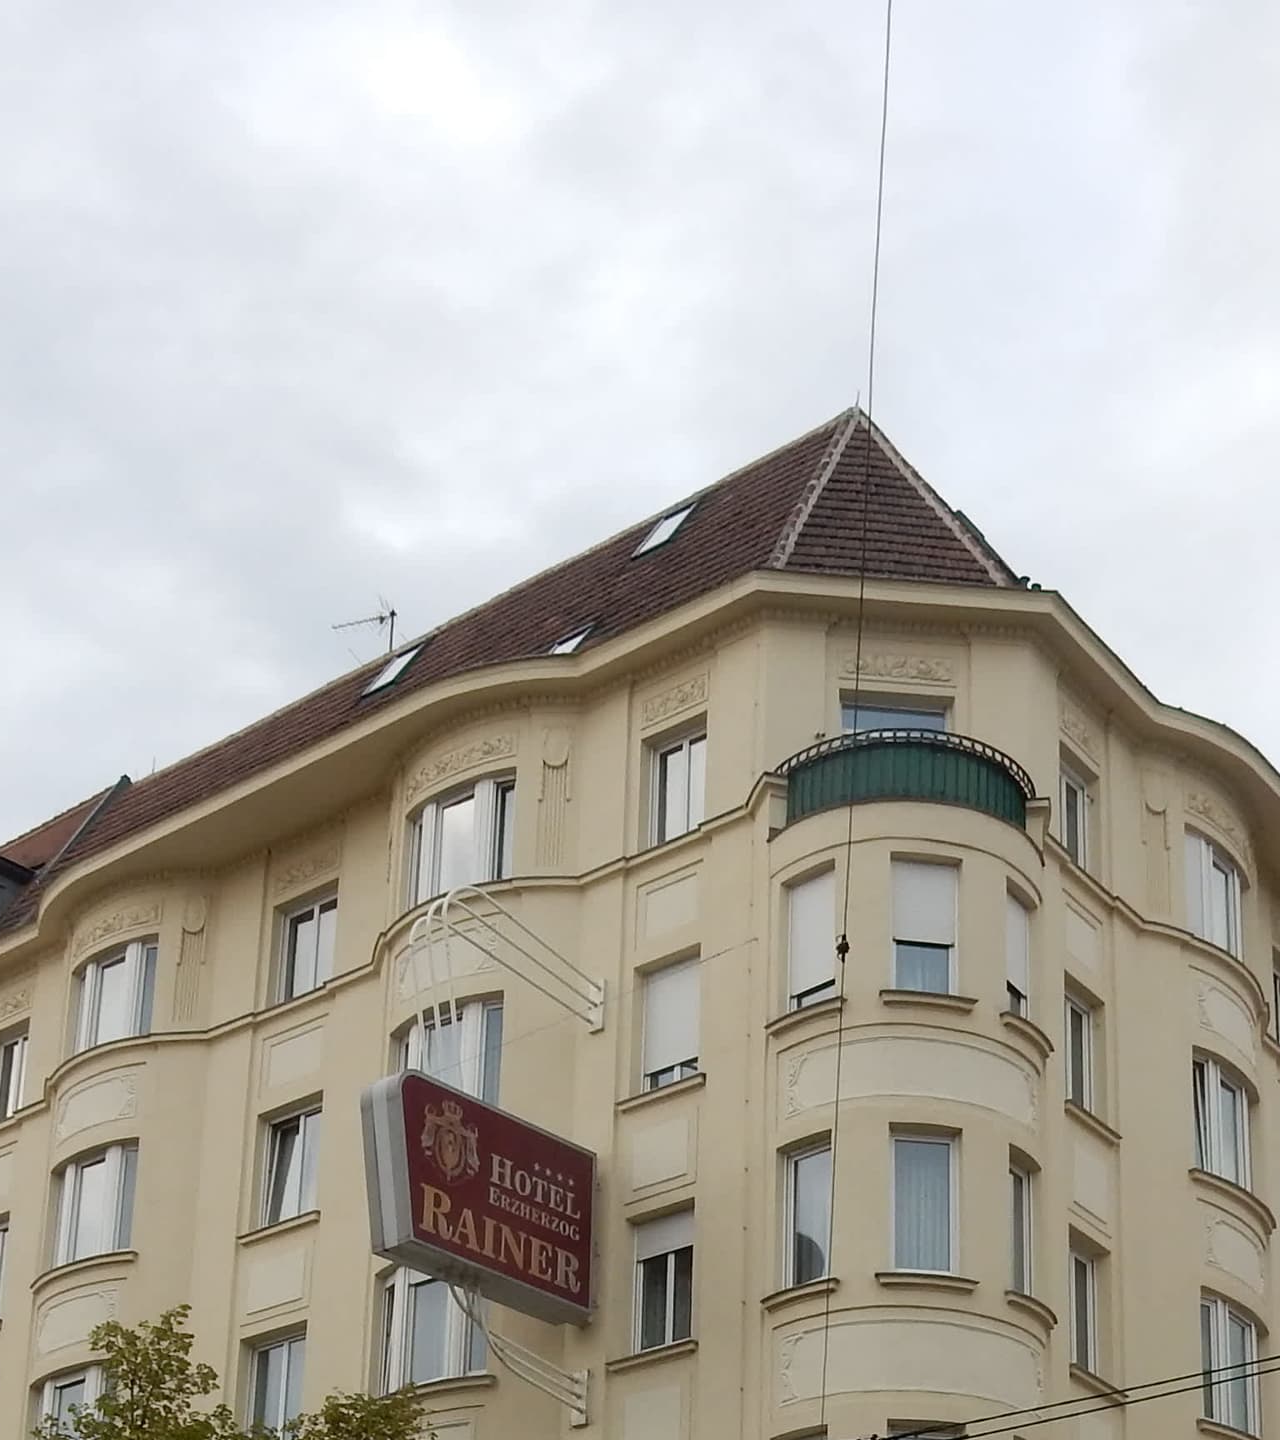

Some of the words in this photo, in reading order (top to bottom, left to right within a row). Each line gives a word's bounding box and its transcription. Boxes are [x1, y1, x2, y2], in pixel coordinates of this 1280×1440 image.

[489, 1186, 580, 1241] ERZHERZOG
[490, 1153, 581, 1220] HOTEL
[419, 1182, 581, 1294] RAINER
